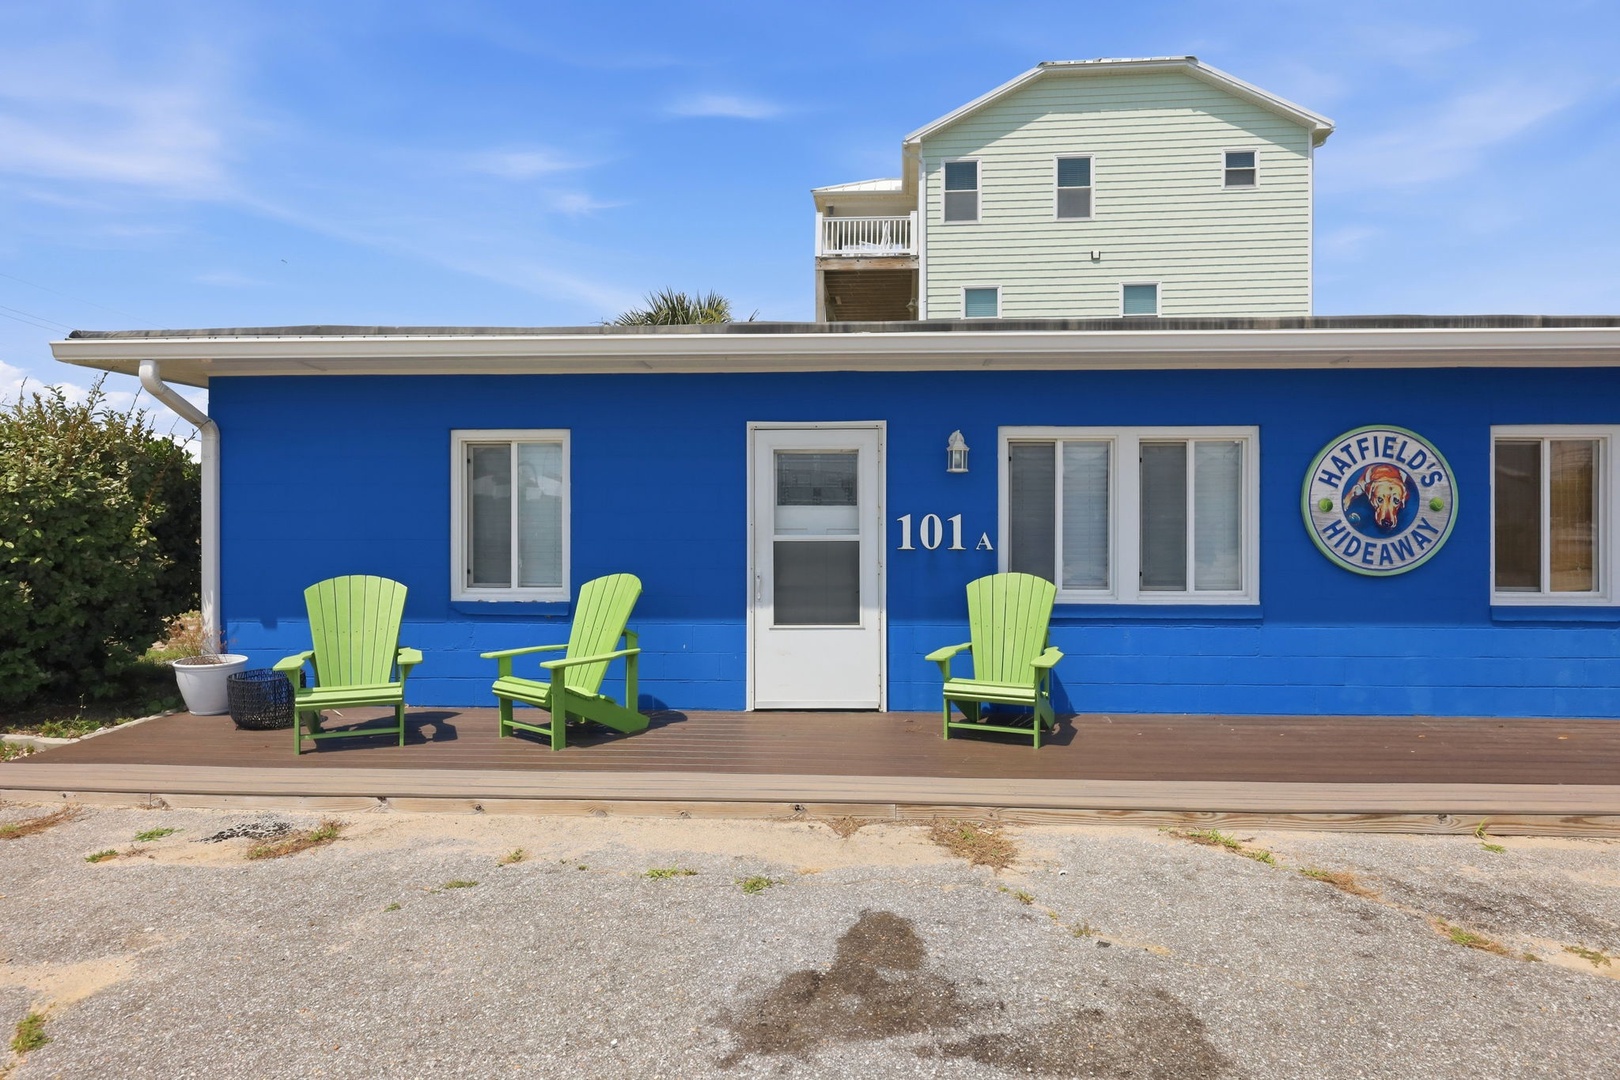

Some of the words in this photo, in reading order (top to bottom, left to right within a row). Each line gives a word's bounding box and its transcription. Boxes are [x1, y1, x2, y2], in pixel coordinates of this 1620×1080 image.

[1318, 436, 1443, 489] HATFIELD'S
[896, 513, 967, 550] 101
[975, 532, 994, 550] A
[1322, 517, 1440, 566] HIDEAWAY
